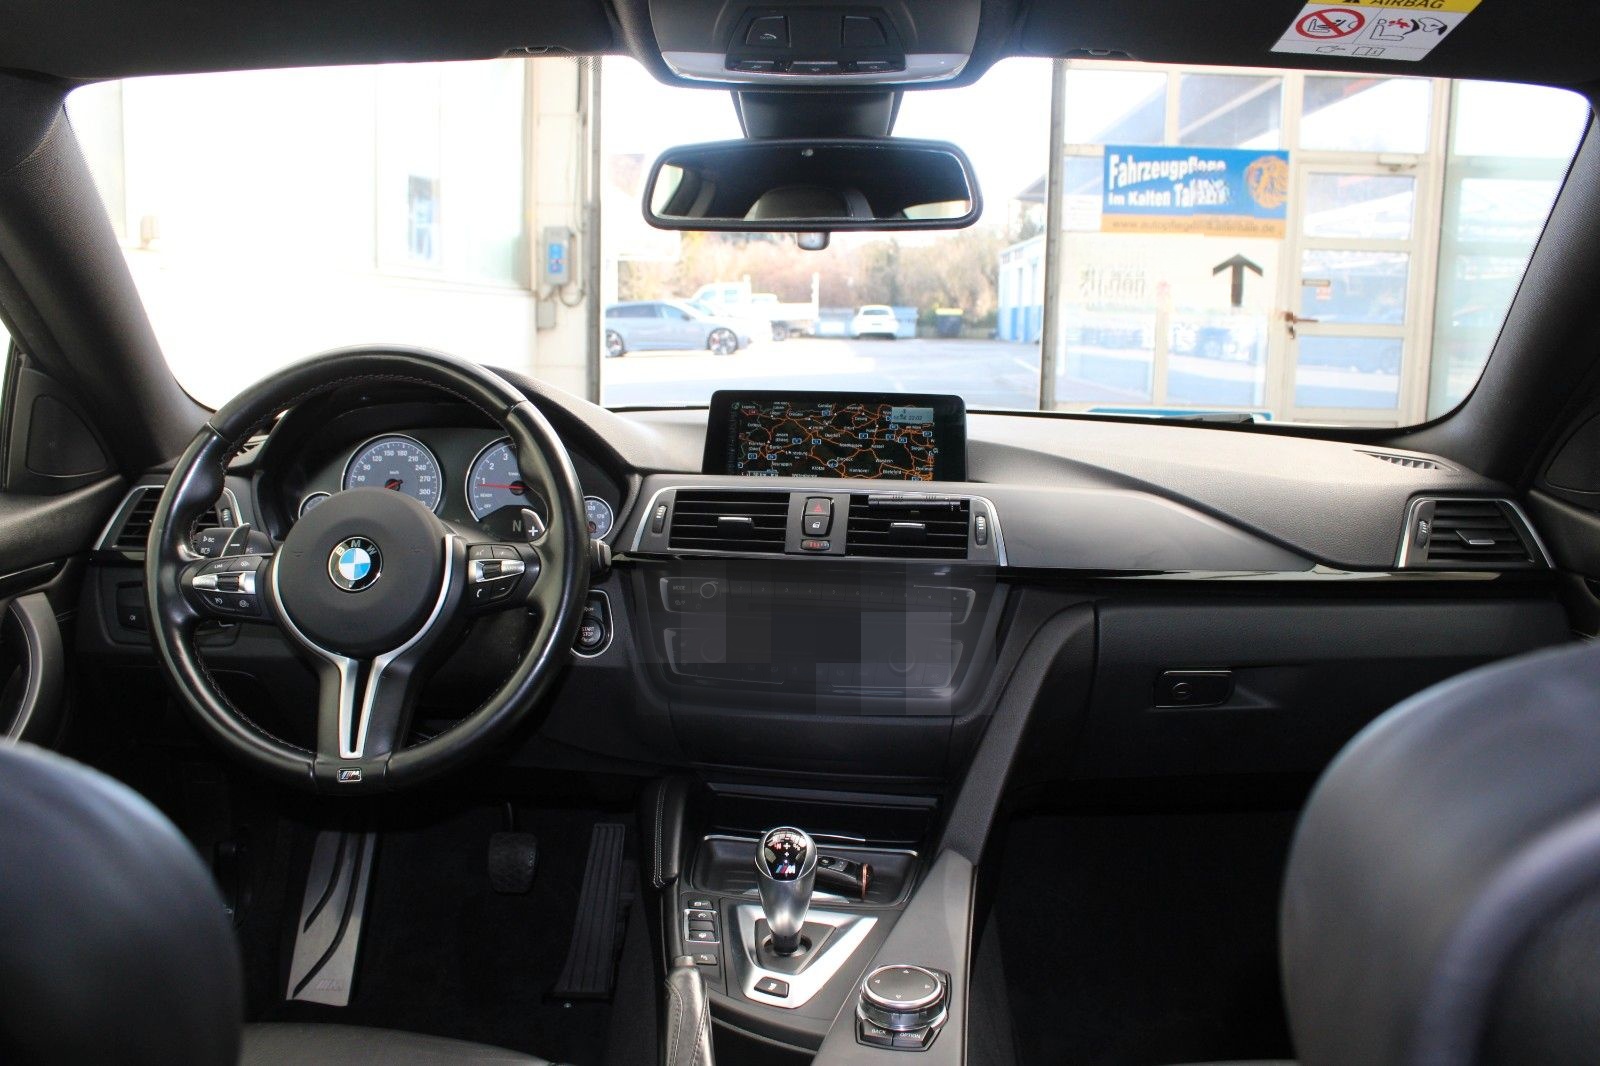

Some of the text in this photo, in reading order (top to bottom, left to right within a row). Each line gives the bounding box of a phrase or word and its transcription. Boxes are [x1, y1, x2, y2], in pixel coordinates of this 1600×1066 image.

[1371, 0, 1445, 9] AIRBAG
[503, 453, 508, 461] 3
[489, 462, 495, 470] 2
[512, 520, 522, 532] N
[335, 539, 377, 556] BMW
